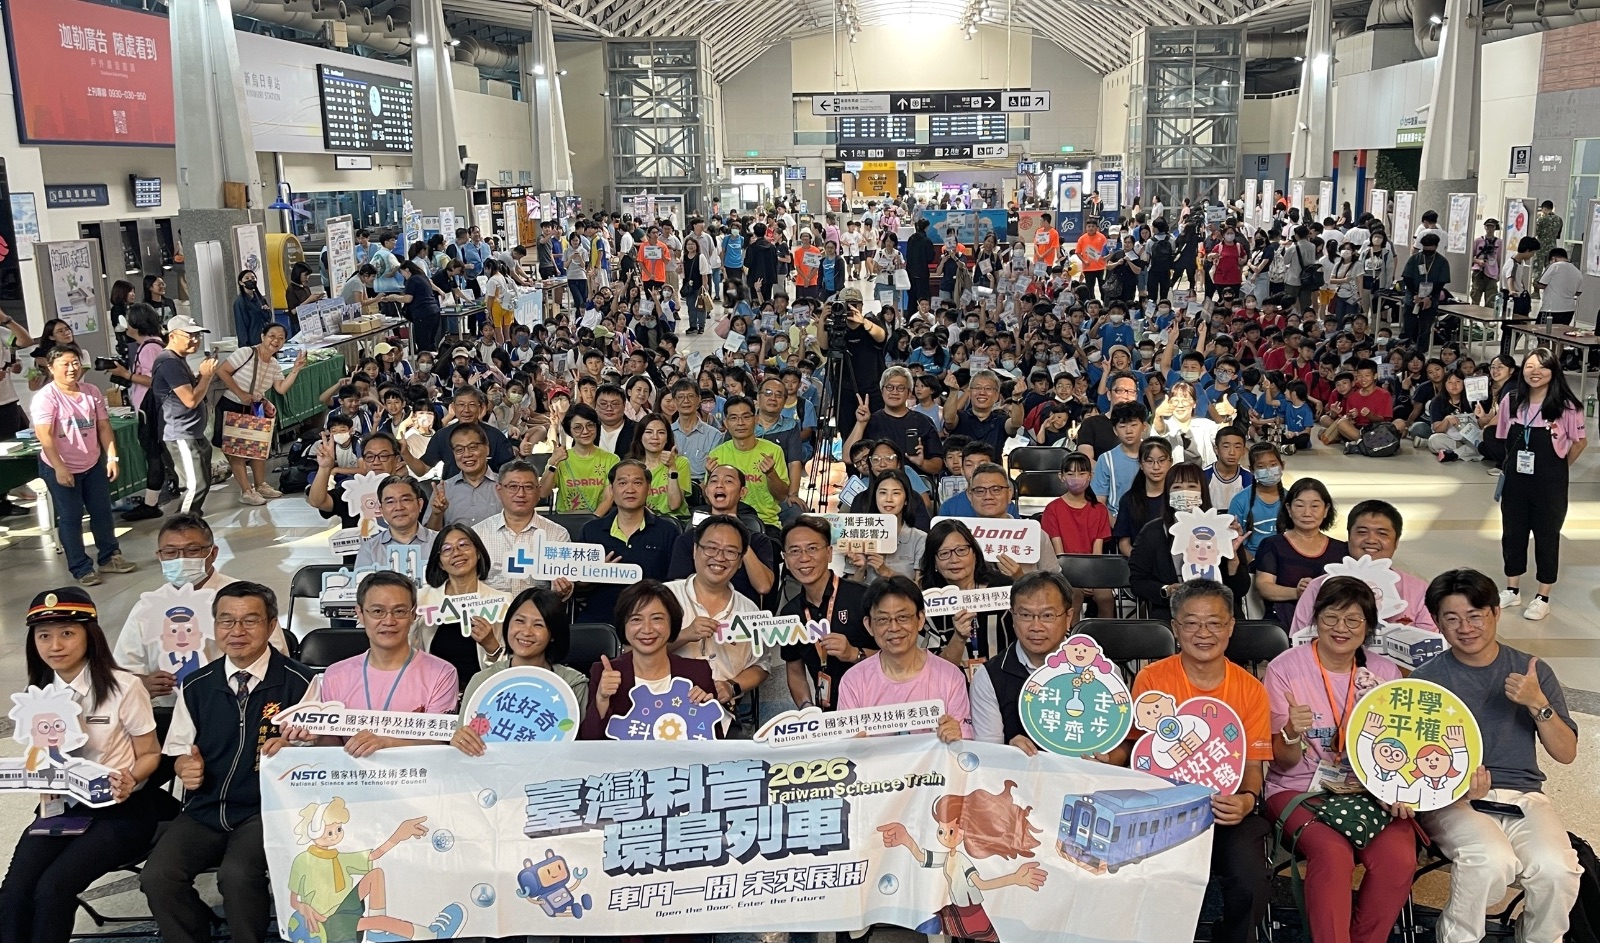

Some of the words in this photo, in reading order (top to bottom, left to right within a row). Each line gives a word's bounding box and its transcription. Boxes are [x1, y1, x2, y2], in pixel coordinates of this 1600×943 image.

[58, 23, 107, 54] 迦勒廣告
[112, 31, 157, 61] 隨處看到
[244, 71, 280, 91] 新烏日車站
[264, 92, 280, 101] STATION
[850, 150, 855, 158] 1
[944, 148, 950, 156] 2
[1047, 165, 1053, 173] 2
[566, 478, 605, 488] SPARK
[844, 516, 884, 527] 攜手擴大
[839, 528, 889, 540] 永續影響力
[970, 525, 1029, 540] bond
[544, 546, 601, 562] 聯華林德
[984, 543, 1034, 556] 華邦電子
[543, 562, 578, 577] Linde
[582, 564, 638, 580] LienHwa
[923, 595, 957, 608] NSTC
[962, 591, 1009, 604] 國家科學及
[1388, 686, 1443, 716] 科學
[292, 712, 340, 725] NSTC
[495, 690, 560, 733] 從好奇
[824, 705, 940, 730] 國家科學及技術委員會
[345, 714, 459, 731] 國家科學及技術委員會
[491, 716, 537, 741] 出發
[774, 720, 819, 736] NSTC
[774, 734, 808, 743] National
[812, 731, 842, 739] Science
[864, 722, 908, 731] Technology
[911, 717, 938, 726] Counci
[1387, 713, 1442, 743] 平權
[383, 727, 426, 737] Technology
[430, 730, 453, 738] Counc
[1169, 736, 1231, 784] 從好奇
[290, 770, 327, 781] NSTC
[330, 767, 428, 780] 國家科學及技術委員會
[768, 756, 853, 788] 2026
[769, 786, 831, 804] Taiwan
[834, 778, 903, 796] Science
[903, 770, 944, 788] Train
[524, 759, 768, 836] 臺灣科普
[602, 798, 848, 876] 環島列車
[607, 873, 738, 911] 車門一開
[742, 859, 869, 898] 未來展開
[655, 909, 682, 918] Open
[685, 906, 703, 914] the
[737, 900, 766, 908] Enter
[769, 897, 787, 905] the
[790, 894, 826, 903] Future
